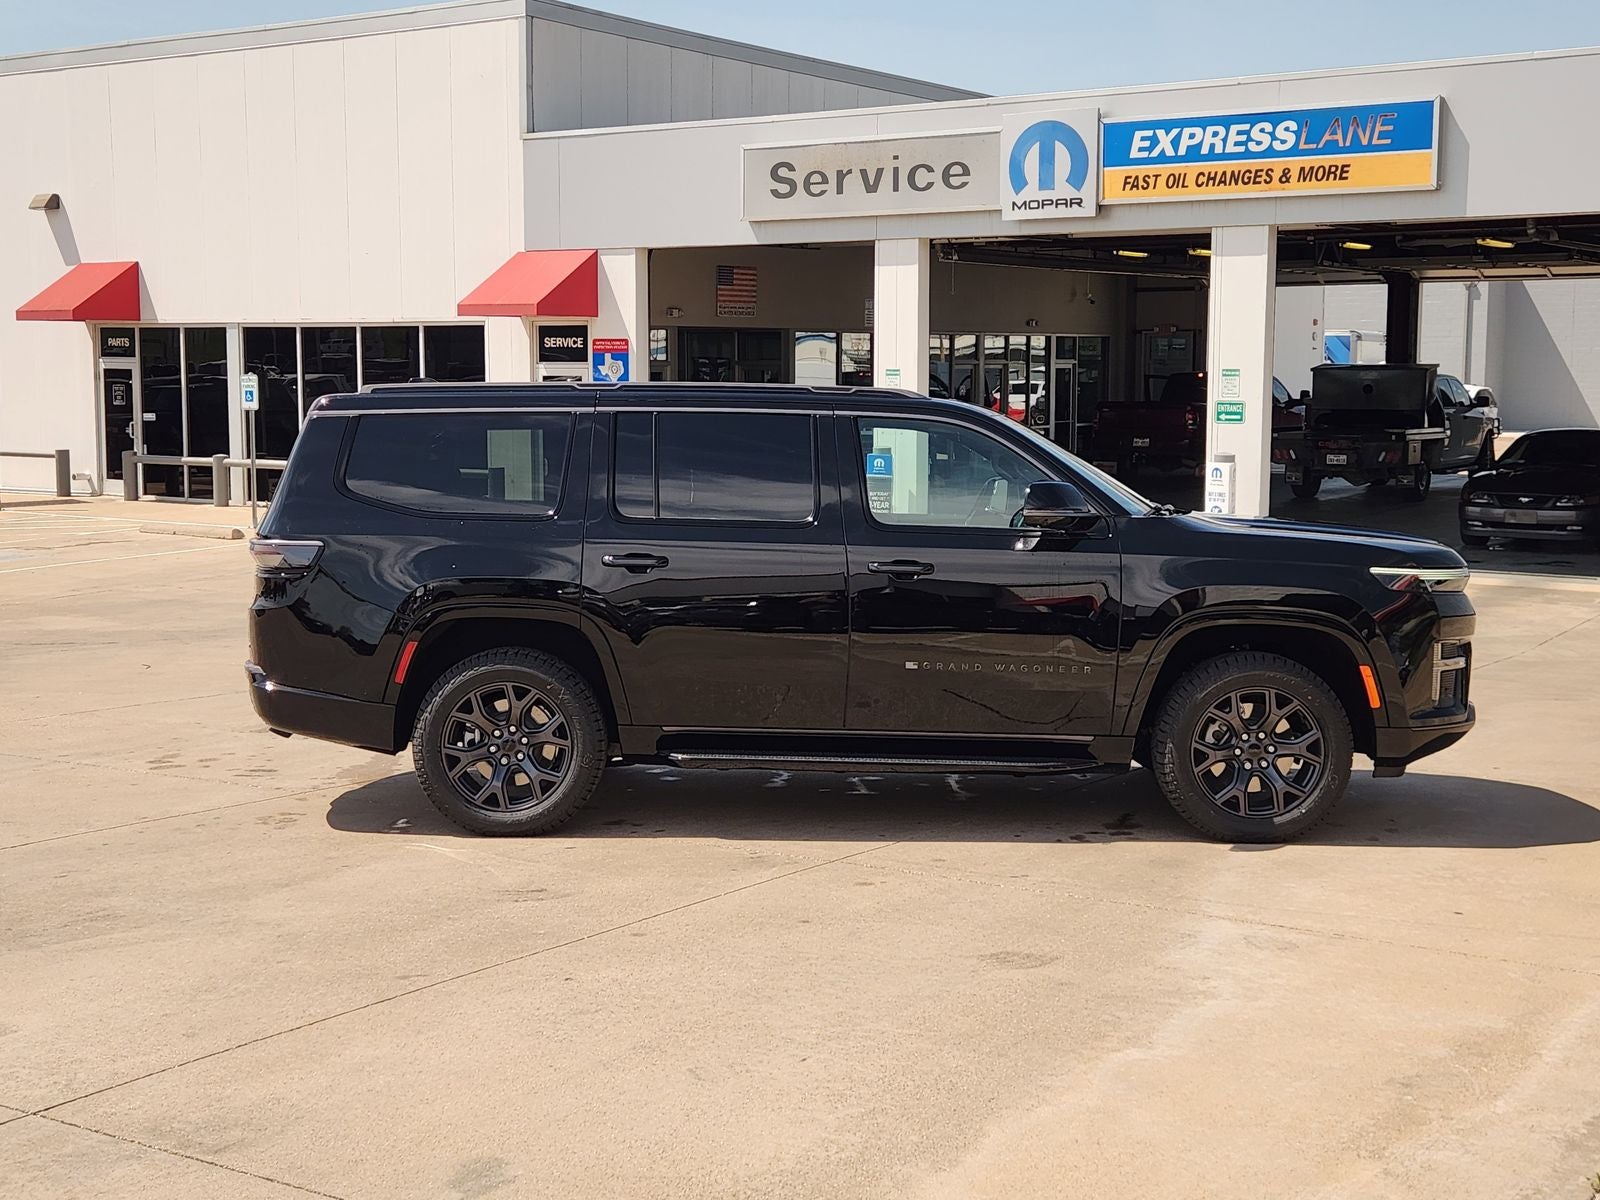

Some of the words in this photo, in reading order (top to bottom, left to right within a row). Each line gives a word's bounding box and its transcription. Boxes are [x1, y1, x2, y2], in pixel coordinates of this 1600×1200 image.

[769, 154, 971, 199] Service
[1122, 173, 1162, 192] FAST
[1165, 172, 1190, 189] OIL
[1195, 168, 1273, 187] CHANGES
[1278, 169, 1292, 184] &
[1296, 164, 1351, 183] MORE
[1011, 197, 1083, 211] MOPAR
[107, 337, 130, 347] PARTS
[544, 337, 584, 348] SERVICE
[1217, 404, 1243, 412] ENTRANCE
[922, 661, 982, 671] GRAND
[994, 663, 1092, 674] WAGONEER
